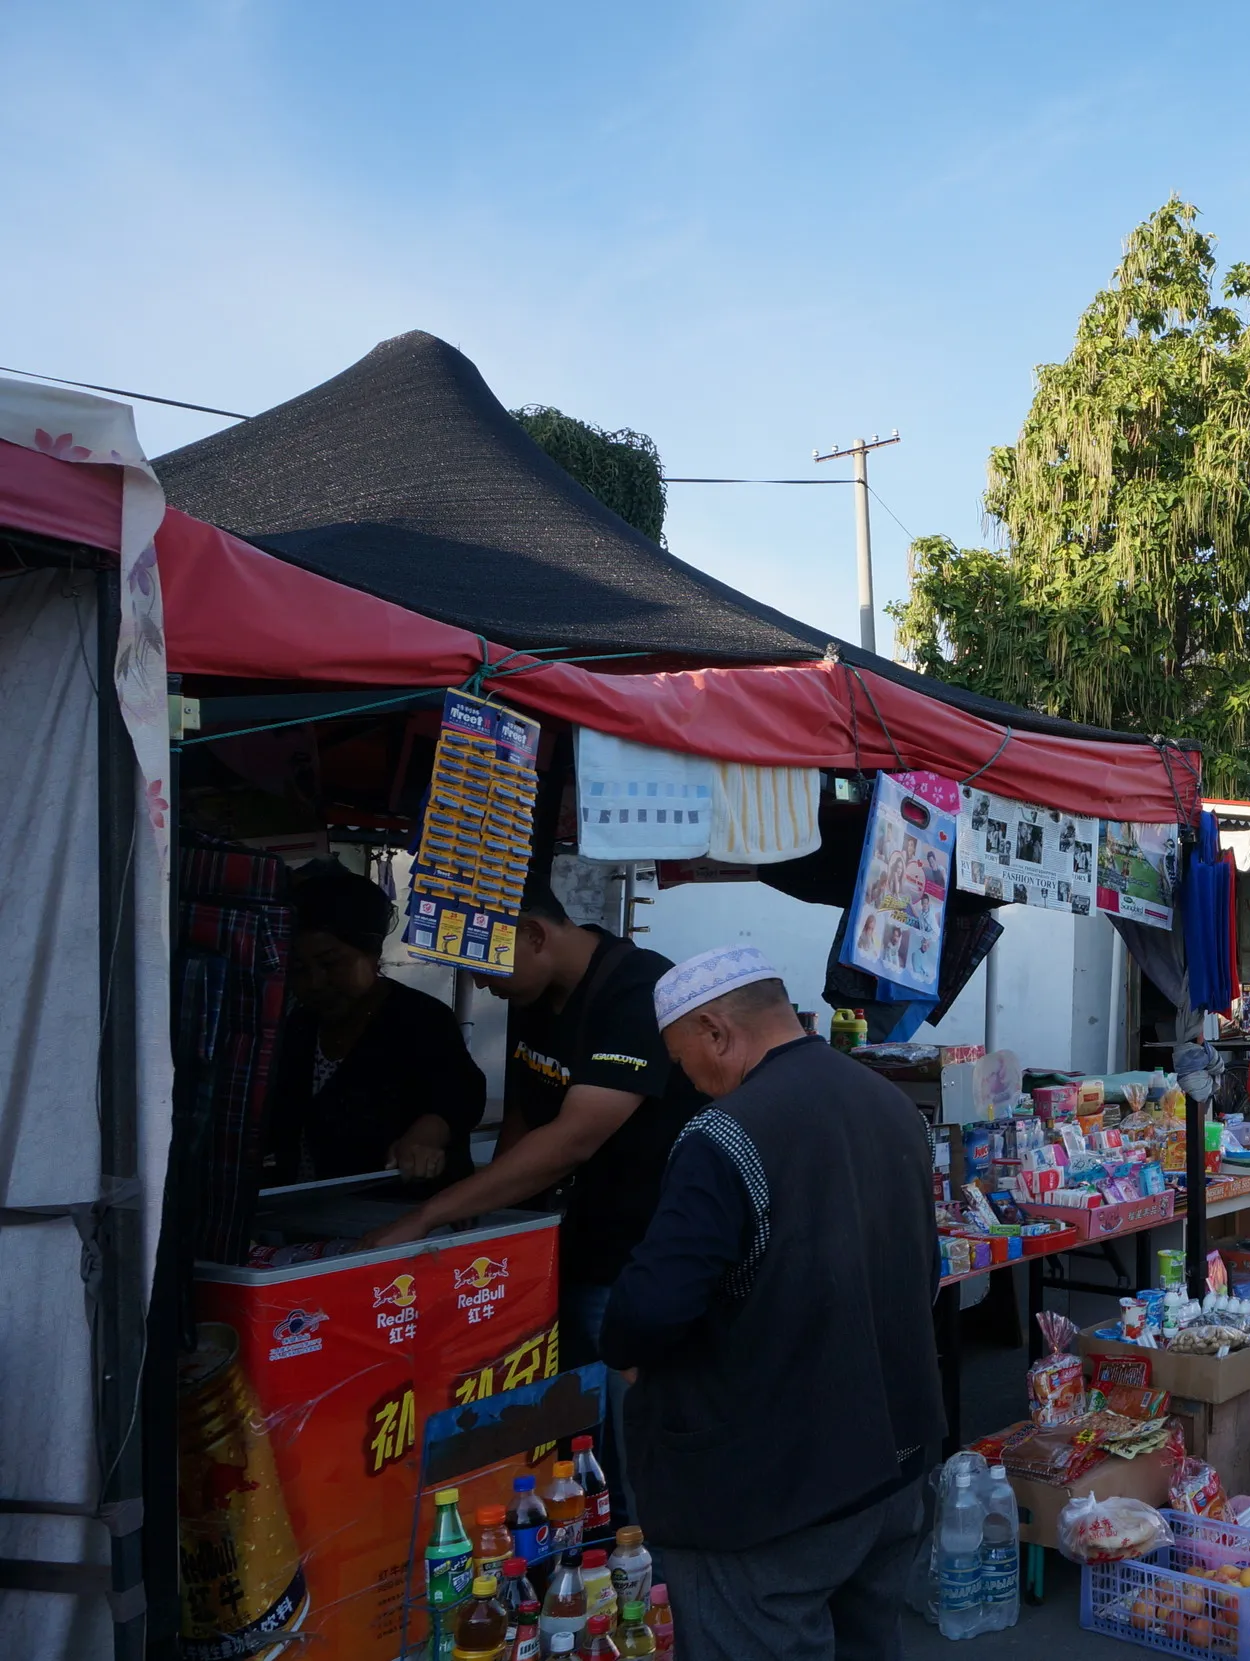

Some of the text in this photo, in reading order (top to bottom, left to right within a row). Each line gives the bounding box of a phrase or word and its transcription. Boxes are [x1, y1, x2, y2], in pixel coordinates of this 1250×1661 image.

[1002, 870, 1058, 889] FASHION TORY
[457, 1284, 505, 1310] RedBull
[376, 1308, 419, 1330] RedB
[467, 1304, 495, 1325] 红牛
[388, 1324, 416, 1345] 红牛
